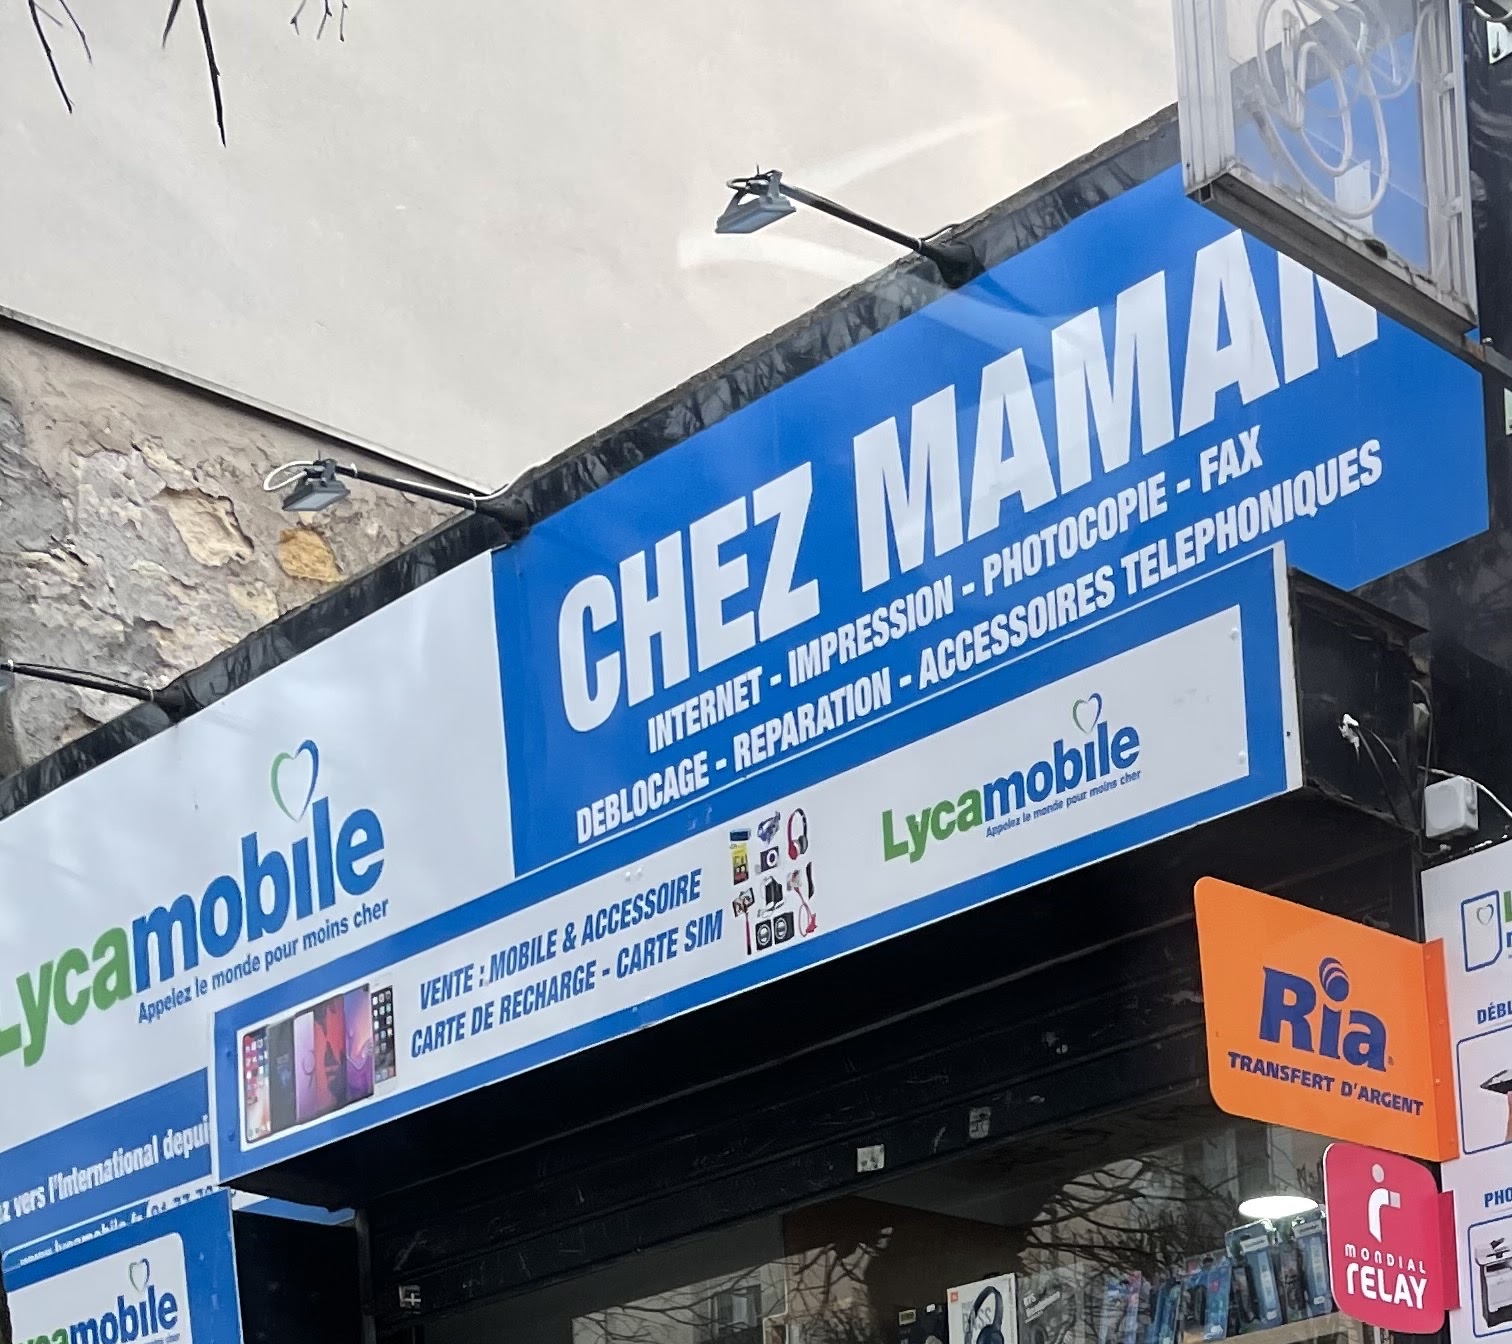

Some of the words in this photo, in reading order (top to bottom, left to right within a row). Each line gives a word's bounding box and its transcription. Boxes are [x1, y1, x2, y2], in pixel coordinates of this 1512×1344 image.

[557, 462, 820, 732] CHEZ
[576, 755, 710, 844] DEBLOCAGE
[734, 665, 891, 767] REPARATION
[919, 560, 1116, 691] ACCESSOIRES
[1122, 439, 1383, 596] TELEPHONIQUES
[648, 662, 760, 752] INTERNET
[789, 575, 953, 689] IMPRESSION
[983, 470, 1167, 597] PHOTOCOPIE
[1200, 425, 1263, 494] FAX
[881, 721, 1140, 864] Lycamobile
[986, 817, 1021, 838] Appelez
[1034, 800, 1064, 819] monde
[1066, 791, 1087, 808] pour
[1089, 779, 1118, 798] moins
[1120, 770, 1141, 786] cher
[138, 985, 192, 1024] Appelez
[195, 977, 208, 998] le
[211, 956, 260, 991] monde
[265, 939, 298, 972] pour
[303, 917, 349, 949] moins
[353, 898, 389, 928] cher
[411, 1013, 465, 1059] CARTE
[471, 1005, 495, 1034] DE
[499, 960, 596, 1025] RECHARGE
[617, 930, 679, 979] CARTE
[684, 909, 724, 953] SIM
[420, 963, 474, 1010] VENTE
[490, 923, 557, 981] MOBILE
[562, 922, 576, 953] &
[581, 869, 703, 944] ACCESSOIRE
[1228, 1051, 1335, 1093] TRANSFERT
[1341, 1080, 1424, 1116] D'ARGENT
[1259, 957, 1388, 1073] Ria
[14, 1185, 46, 1219] vers
[48, 1134, 159, 1203] l'International
